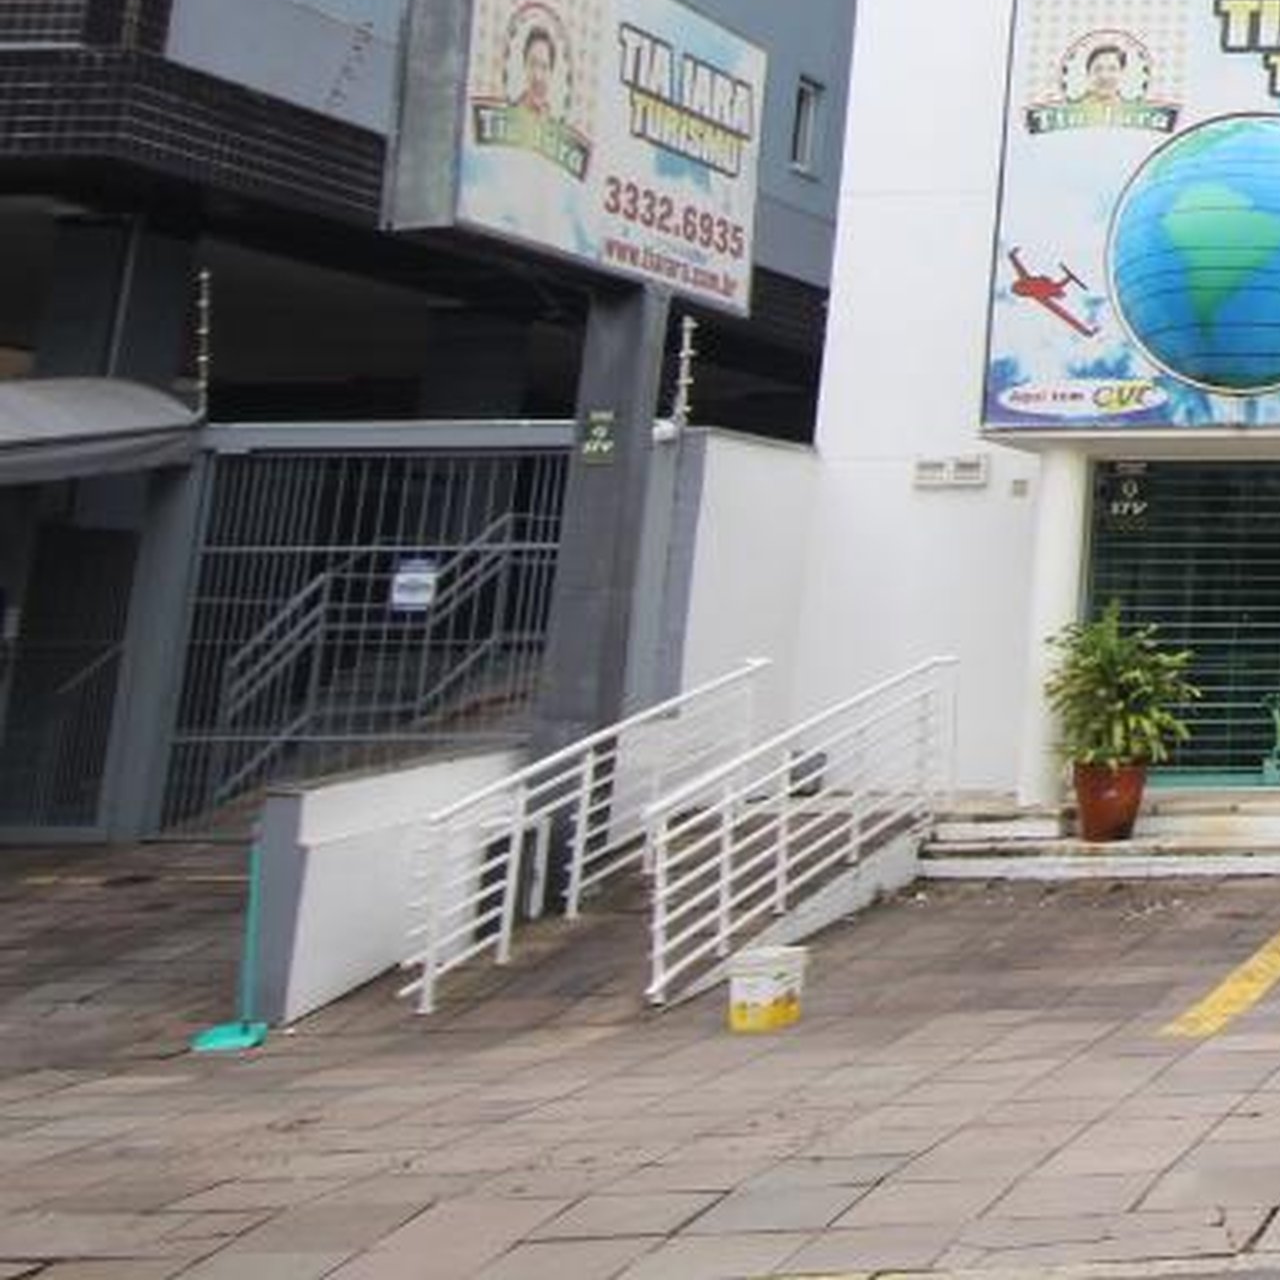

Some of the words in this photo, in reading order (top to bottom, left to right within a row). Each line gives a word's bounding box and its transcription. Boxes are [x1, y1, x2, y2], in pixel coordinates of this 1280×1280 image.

[619, 22, 675, 106] TIA
[672, 51, 753, 141] IARA
[630, 88, 742, 178] TURISMO
[604, 176, 745, 260] 3332.6935
